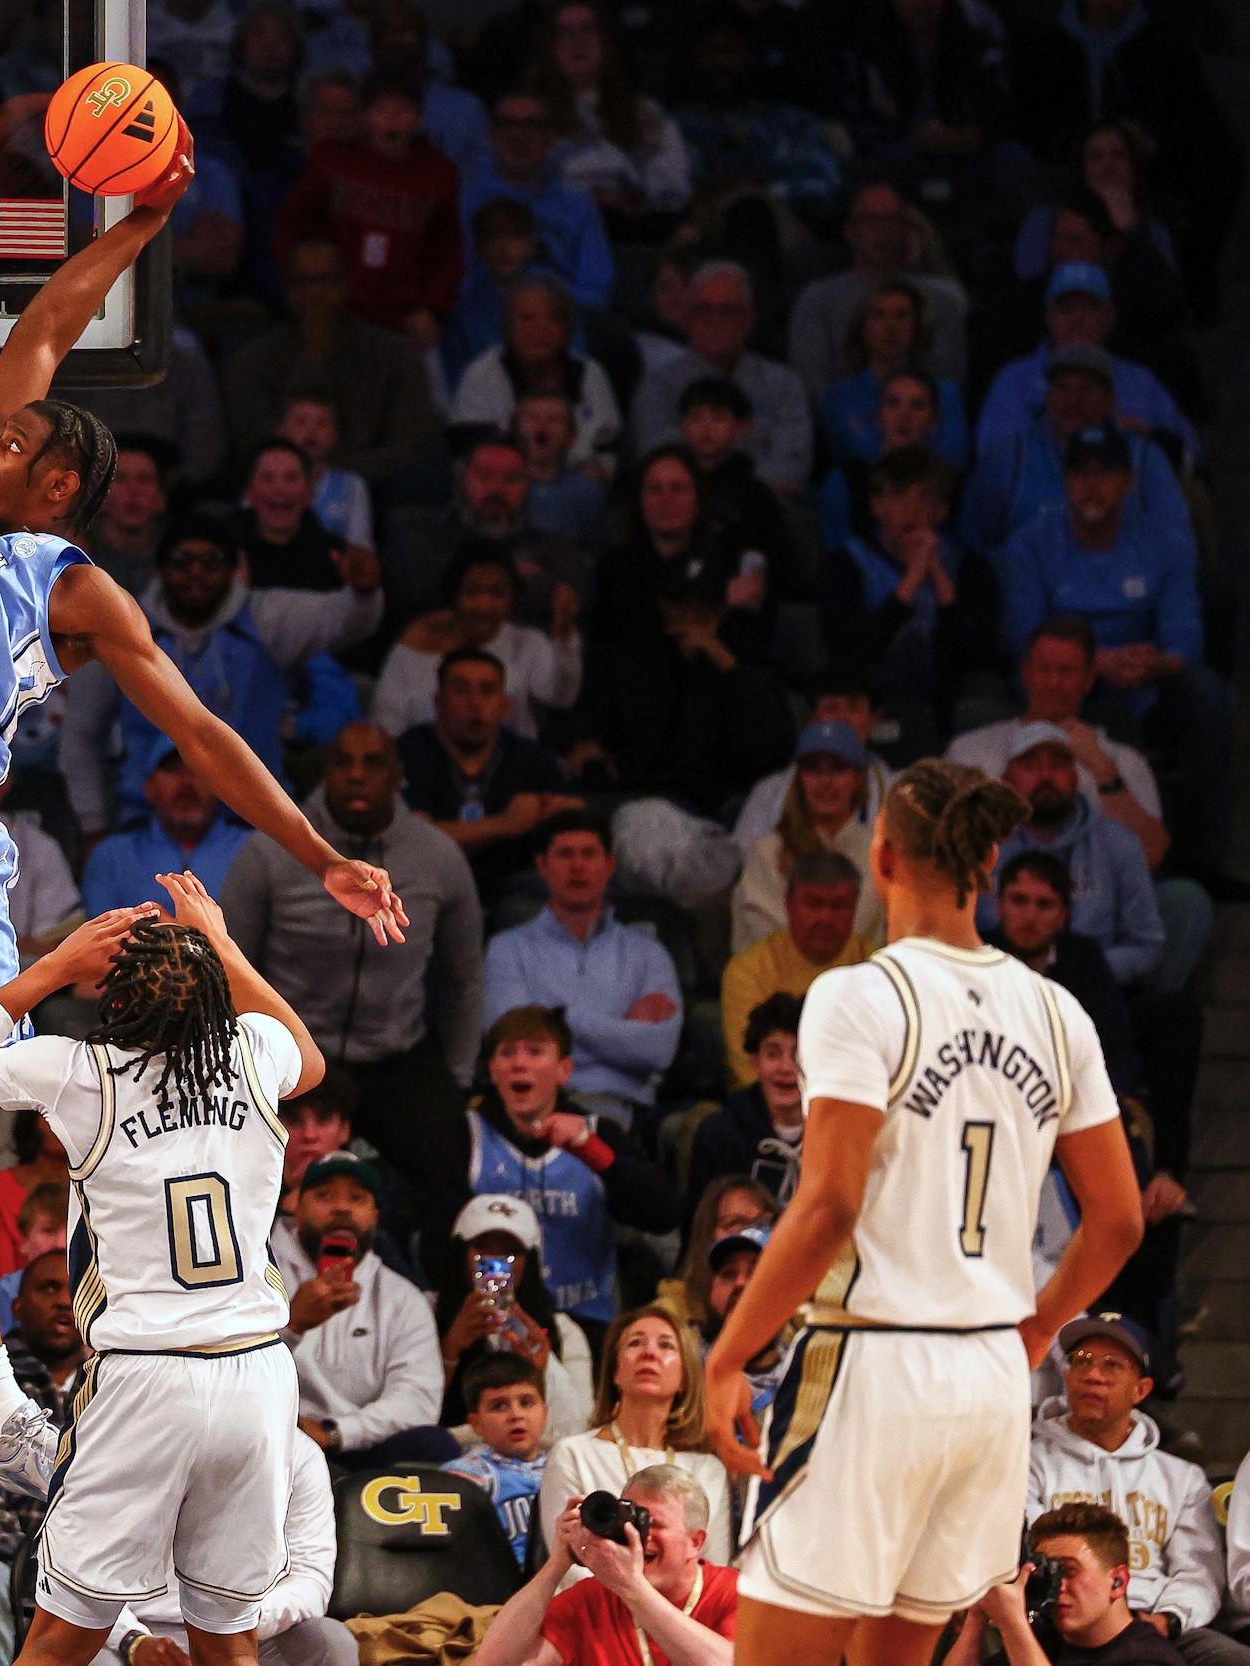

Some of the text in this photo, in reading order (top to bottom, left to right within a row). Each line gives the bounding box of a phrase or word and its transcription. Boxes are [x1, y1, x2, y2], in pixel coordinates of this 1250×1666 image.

[905, 1029, 1059, 1132] WASHINGTON
[163, 1171, 245, 1291] 0
[959, 1121, 995, 1258] 1
[360, 1475, 462, 1536] GT
